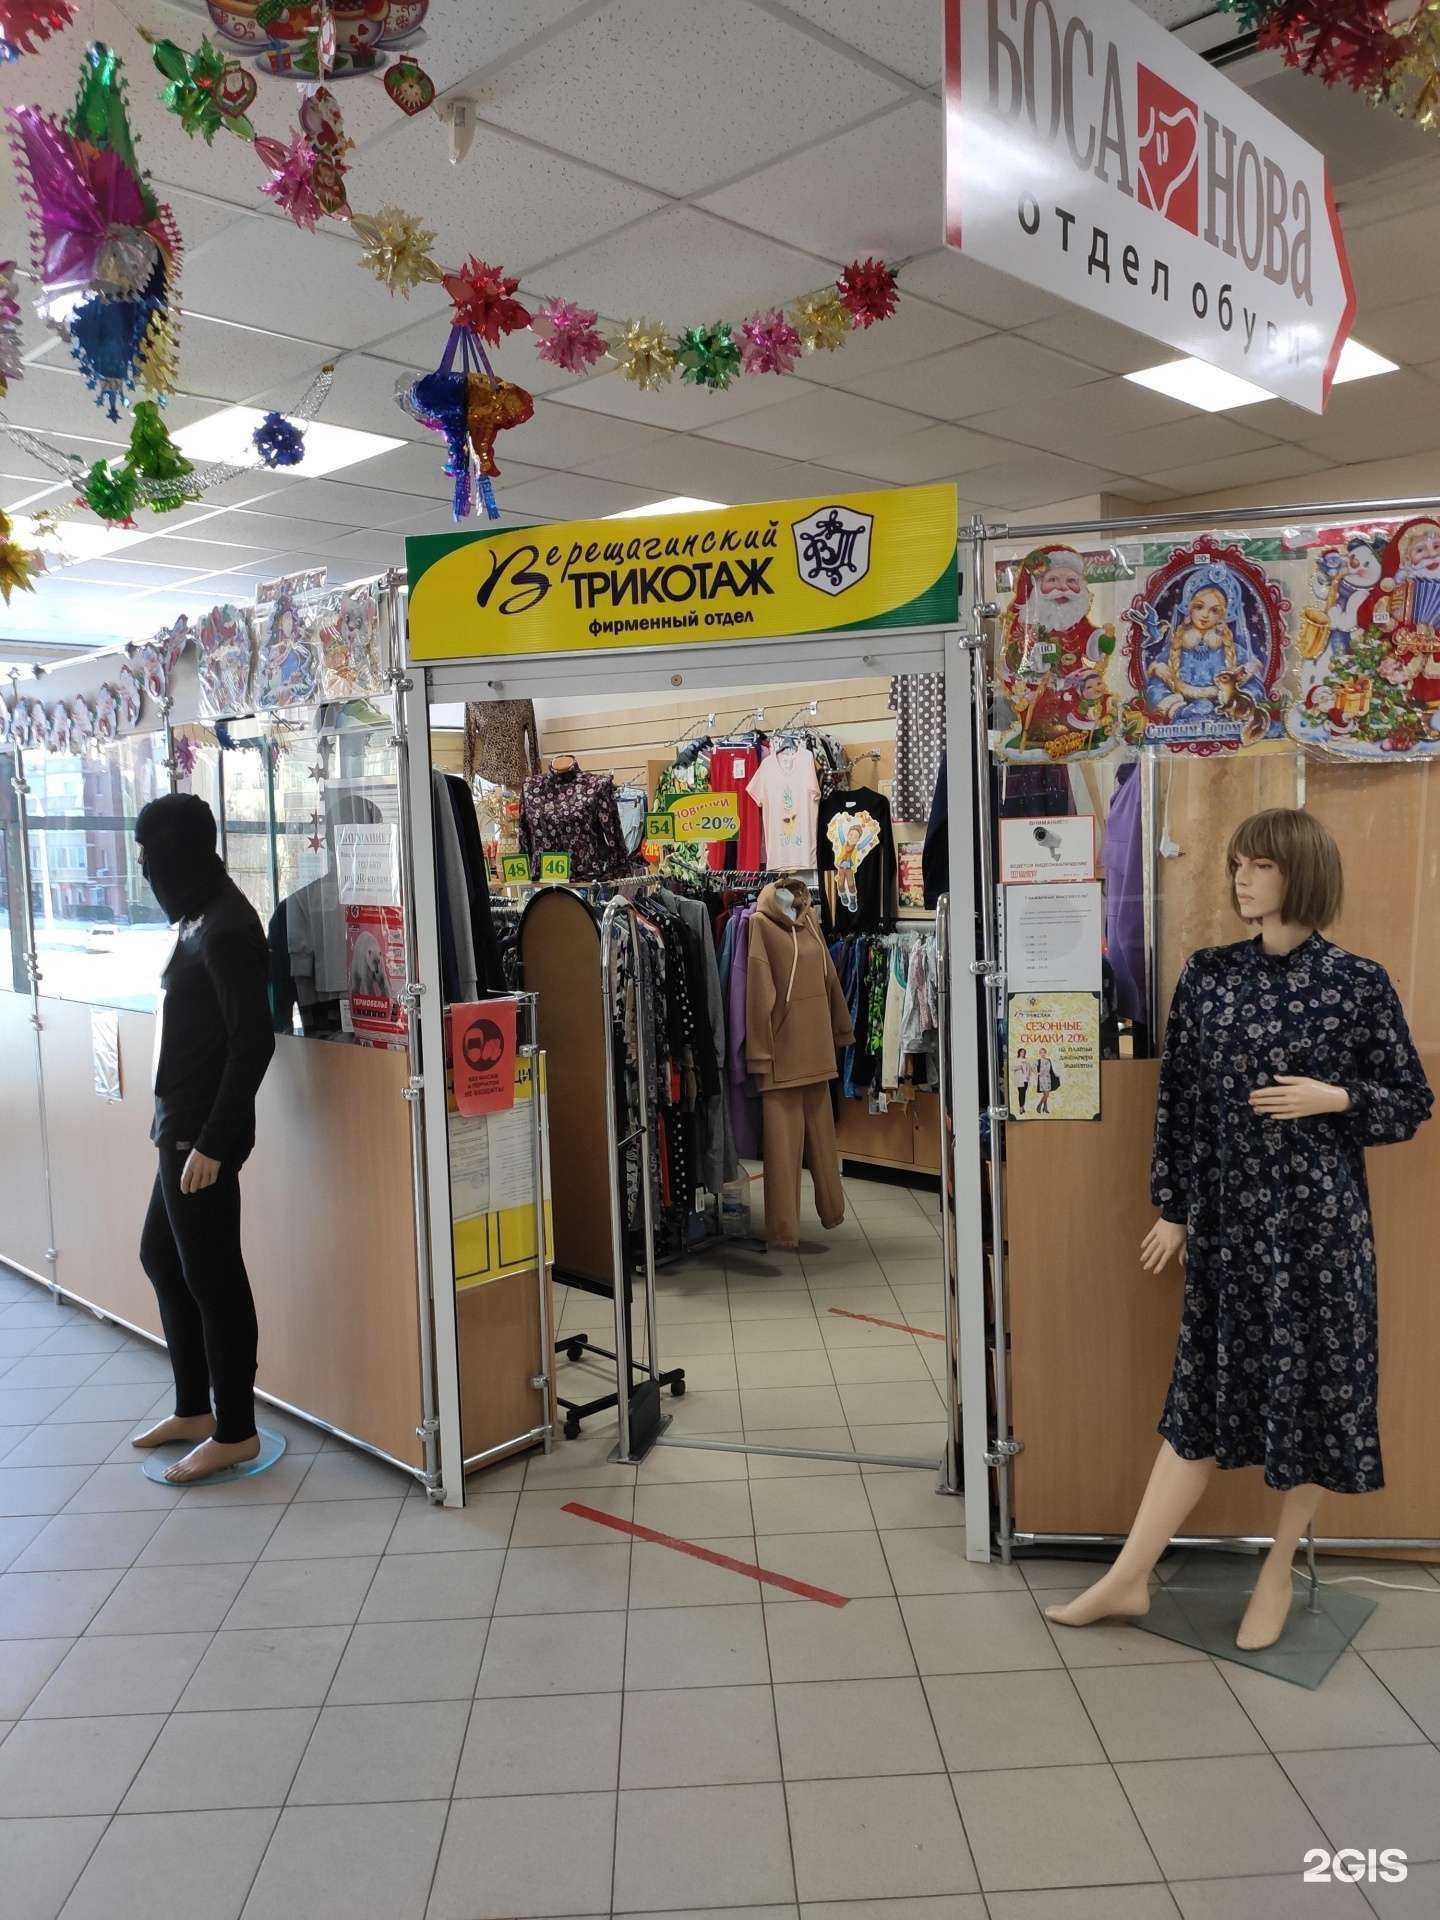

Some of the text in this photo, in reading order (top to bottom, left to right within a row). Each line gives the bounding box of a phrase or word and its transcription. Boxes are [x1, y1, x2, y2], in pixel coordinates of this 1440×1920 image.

[1017, 189, 1170, 302] отдел
[476, 520, 779, 616] Верещагинский
[567, 556, 775, 609] ТРИКОТАЖ
[588, 610, 755, 637] фирменный отдел
[649, 820, 671, 835] 54
[695, 816, 736, 830] -20%
[507, 863, 526, 877] 48
[545, 860, 565, 874] 46
[1025, 1021, 1082, 1031] СЕЗОННЫЕ
[1020, 1033, 1088, 1043] СКИДКИ 20%
